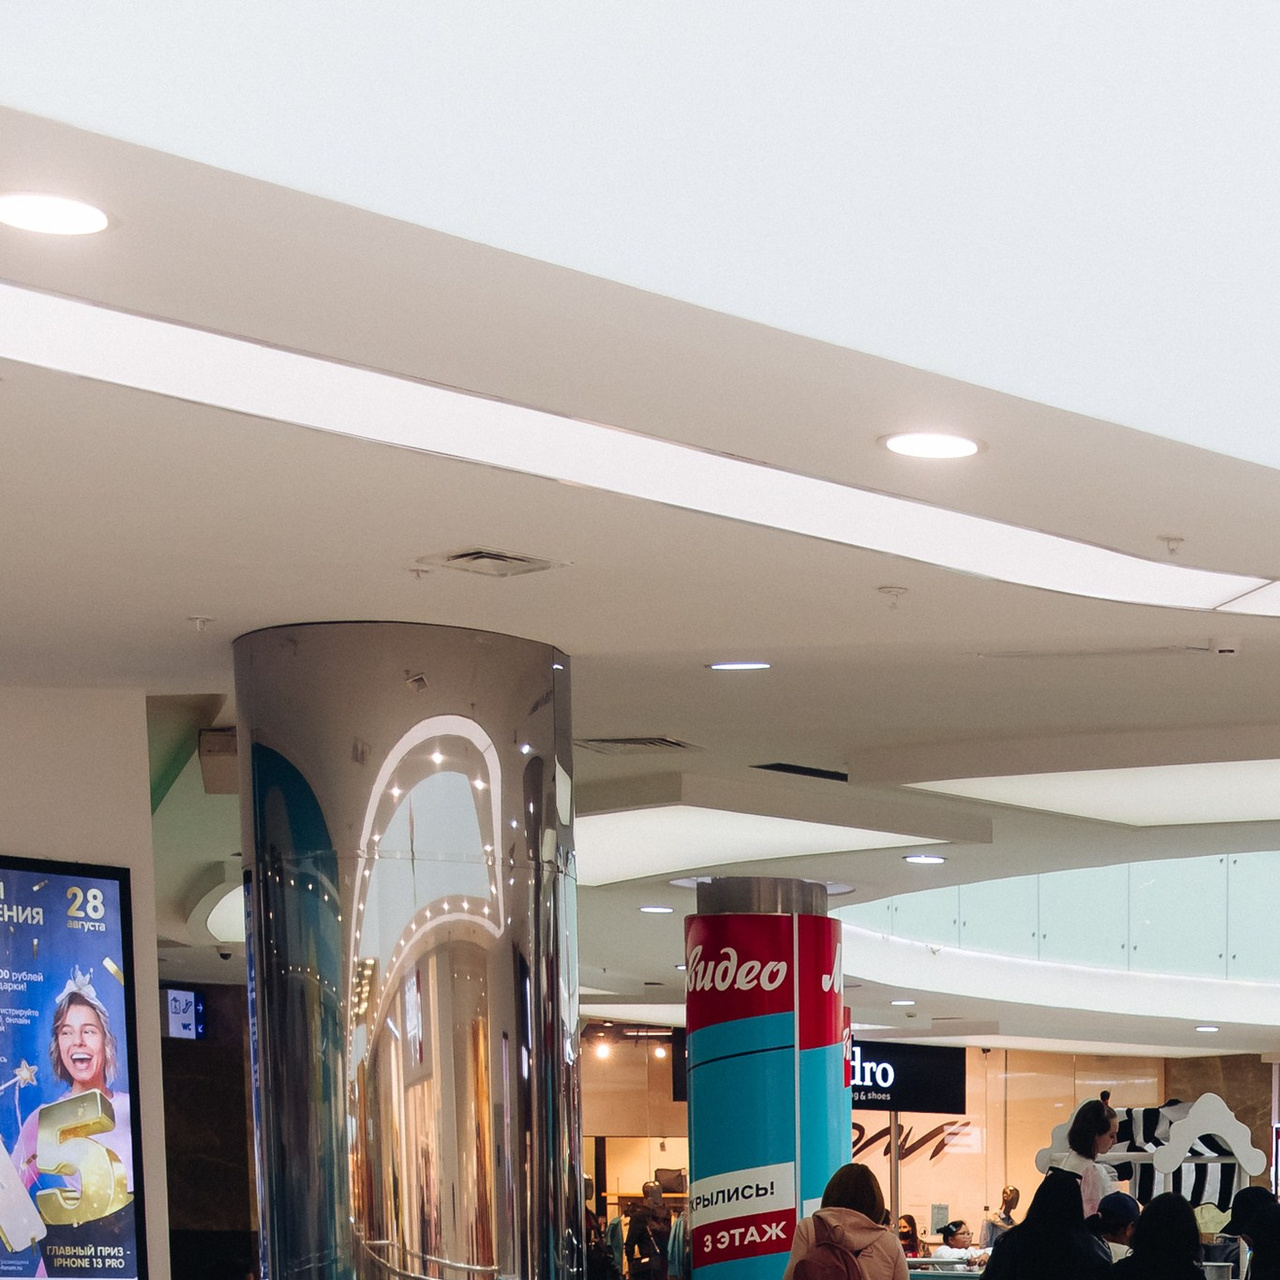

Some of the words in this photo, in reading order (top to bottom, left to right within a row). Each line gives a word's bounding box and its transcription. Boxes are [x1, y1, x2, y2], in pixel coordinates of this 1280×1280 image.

[66, 886, 106, 925] 28
[66, 919, 106, 932] августа
[12, 971, 44, 982] рублей
[181, 1022, 192, 1032] WC
[867, 1090, 891, 1100] shoes
[703, 1234, 712, 1253] 3
[716, 1221, 787, 1249] ЭТАЖ
[46, 1244, 95, 1257] ГЛАВНЫЙ
[97, 1246, 124, 1257] ПРИЗ
[53, 1258, 91, 1268] IPHONE
[92, 1258, 103, 1268] 13
[105, 1258, 125, 1269] PRO
